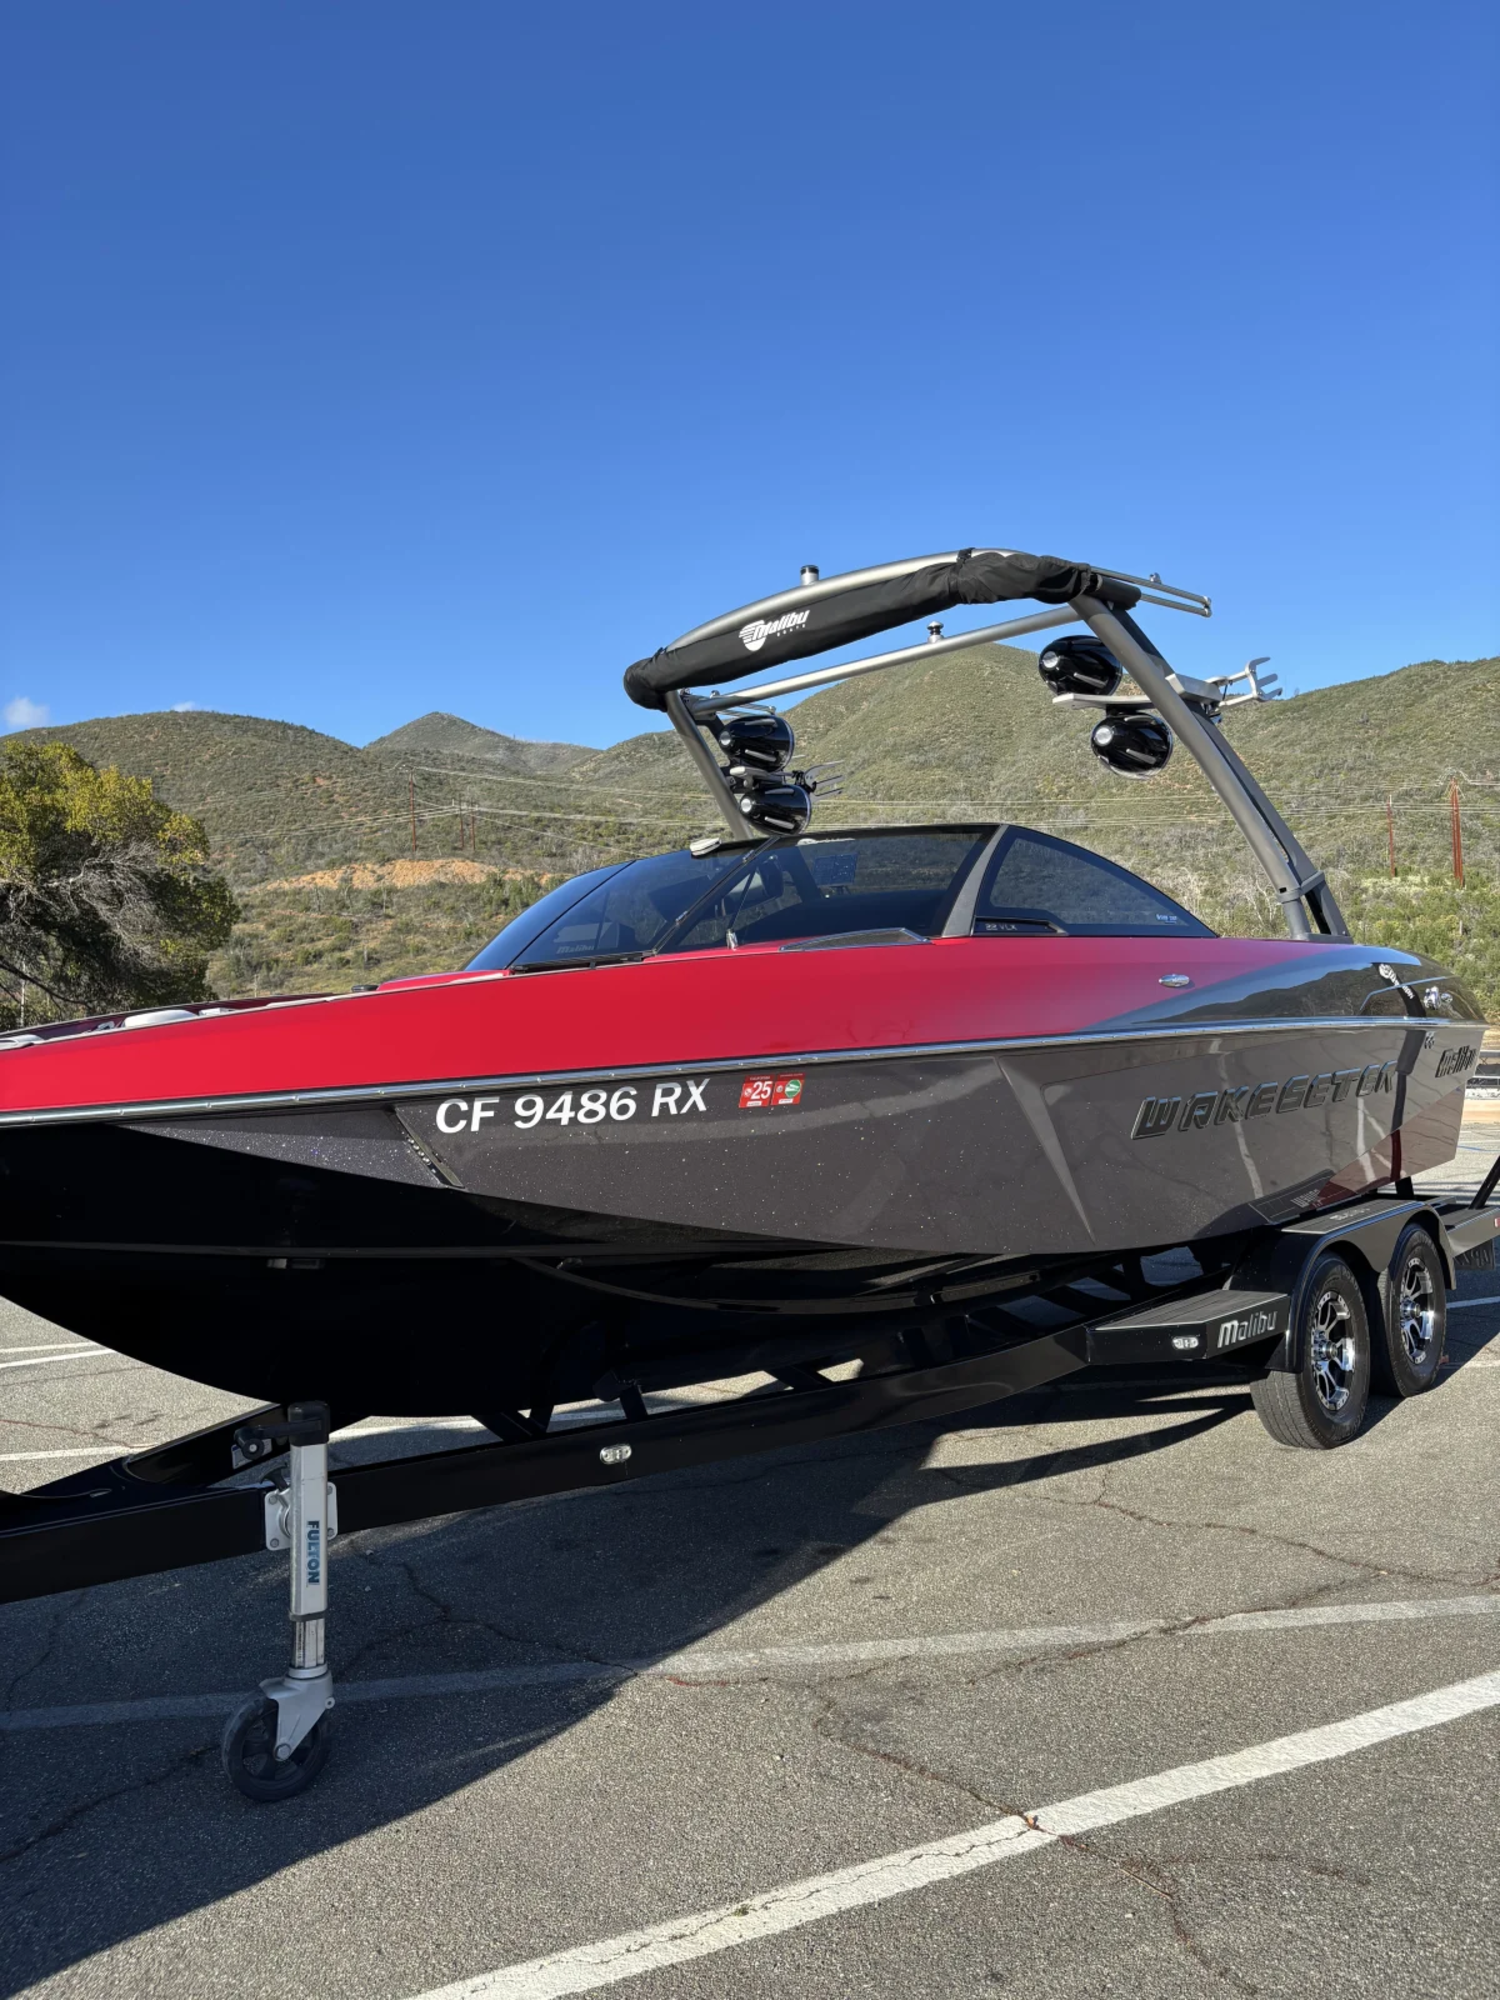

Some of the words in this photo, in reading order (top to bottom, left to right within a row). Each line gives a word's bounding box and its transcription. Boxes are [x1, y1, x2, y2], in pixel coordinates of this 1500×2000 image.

[752, 609, 811, 641] Malibu
[435, 1096, 500, 1134] CF
[513, 1086, 638, 1130] 9486
[650, 1078, 711, 1118] RX
[750, 1080, 774, 1100] 25
[1217, 1310, 1278, 1349] Malibu
[307, 1520, 320, 1584] FULTON
